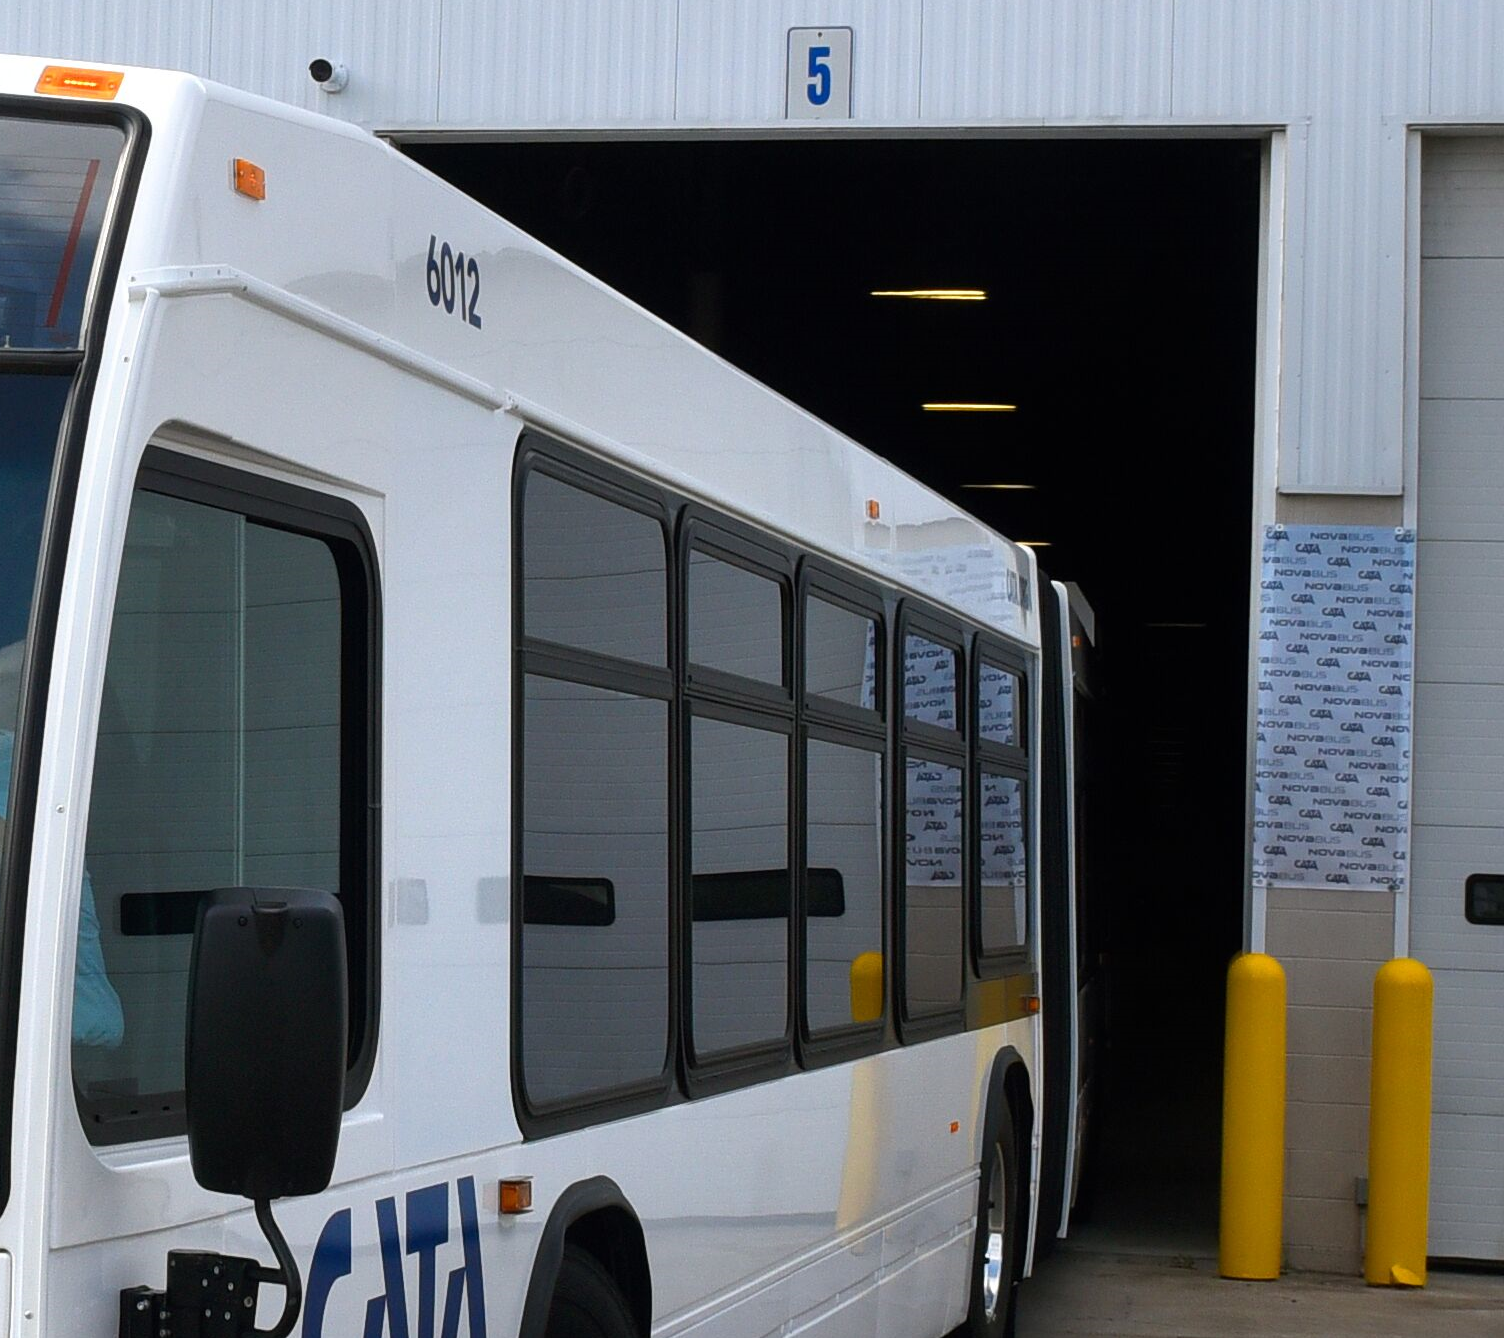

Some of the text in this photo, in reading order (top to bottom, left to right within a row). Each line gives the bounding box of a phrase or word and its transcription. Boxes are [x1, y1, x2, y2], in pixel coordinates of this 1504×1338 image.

[807, 46, 832, 106] 5
[426, 235, 482, 330] 6012
[1266, 530, 1290, 542] CATA
[1296, 543, 1320, 555] CATA
[1327, 557, 1351, 568] CATA
[1358, 570, 1382, 582] CATA
[1260, 580, 1285, 592] CATA
[1291, 593, 1315, 605] CATA
[1322, 607, 1346, 619] CATA
[1353, 621, 1377, 632] CATA
[1384, 634, 1408, 646] CATA
[1286, 644, 1310, 655] CATA
[1316, 657, 1341, 669] CATA
[1347, 671, 1372, 683] CATA
[1379, 685, 1403, 697] CATA
[1279, 695, 1303, 706] CATA
[1309, 709, 1333, 720] CATA
[1340, 722, 1364, 734] CATA
[1371, 736, 1396, 748] CATA
[1273, 745, 1297, 756] CATA
[1304, 759, 1328, 770] CATA
[1335, 773, 1359, 784] CATA
[1366, 786, 1390, 798] CATA
[1268, 795, 1292, 807] CATA
[1299, 809, 1323, 820] CATA
[1330, 823, 1354, 834] CATA
[1361, 837, 1386, 848] CATA
[1263, 845, 1288, 857] CATA
[1294, 859, 1318, 871] CATA
[1325, 873, 1350, 885] CATA
